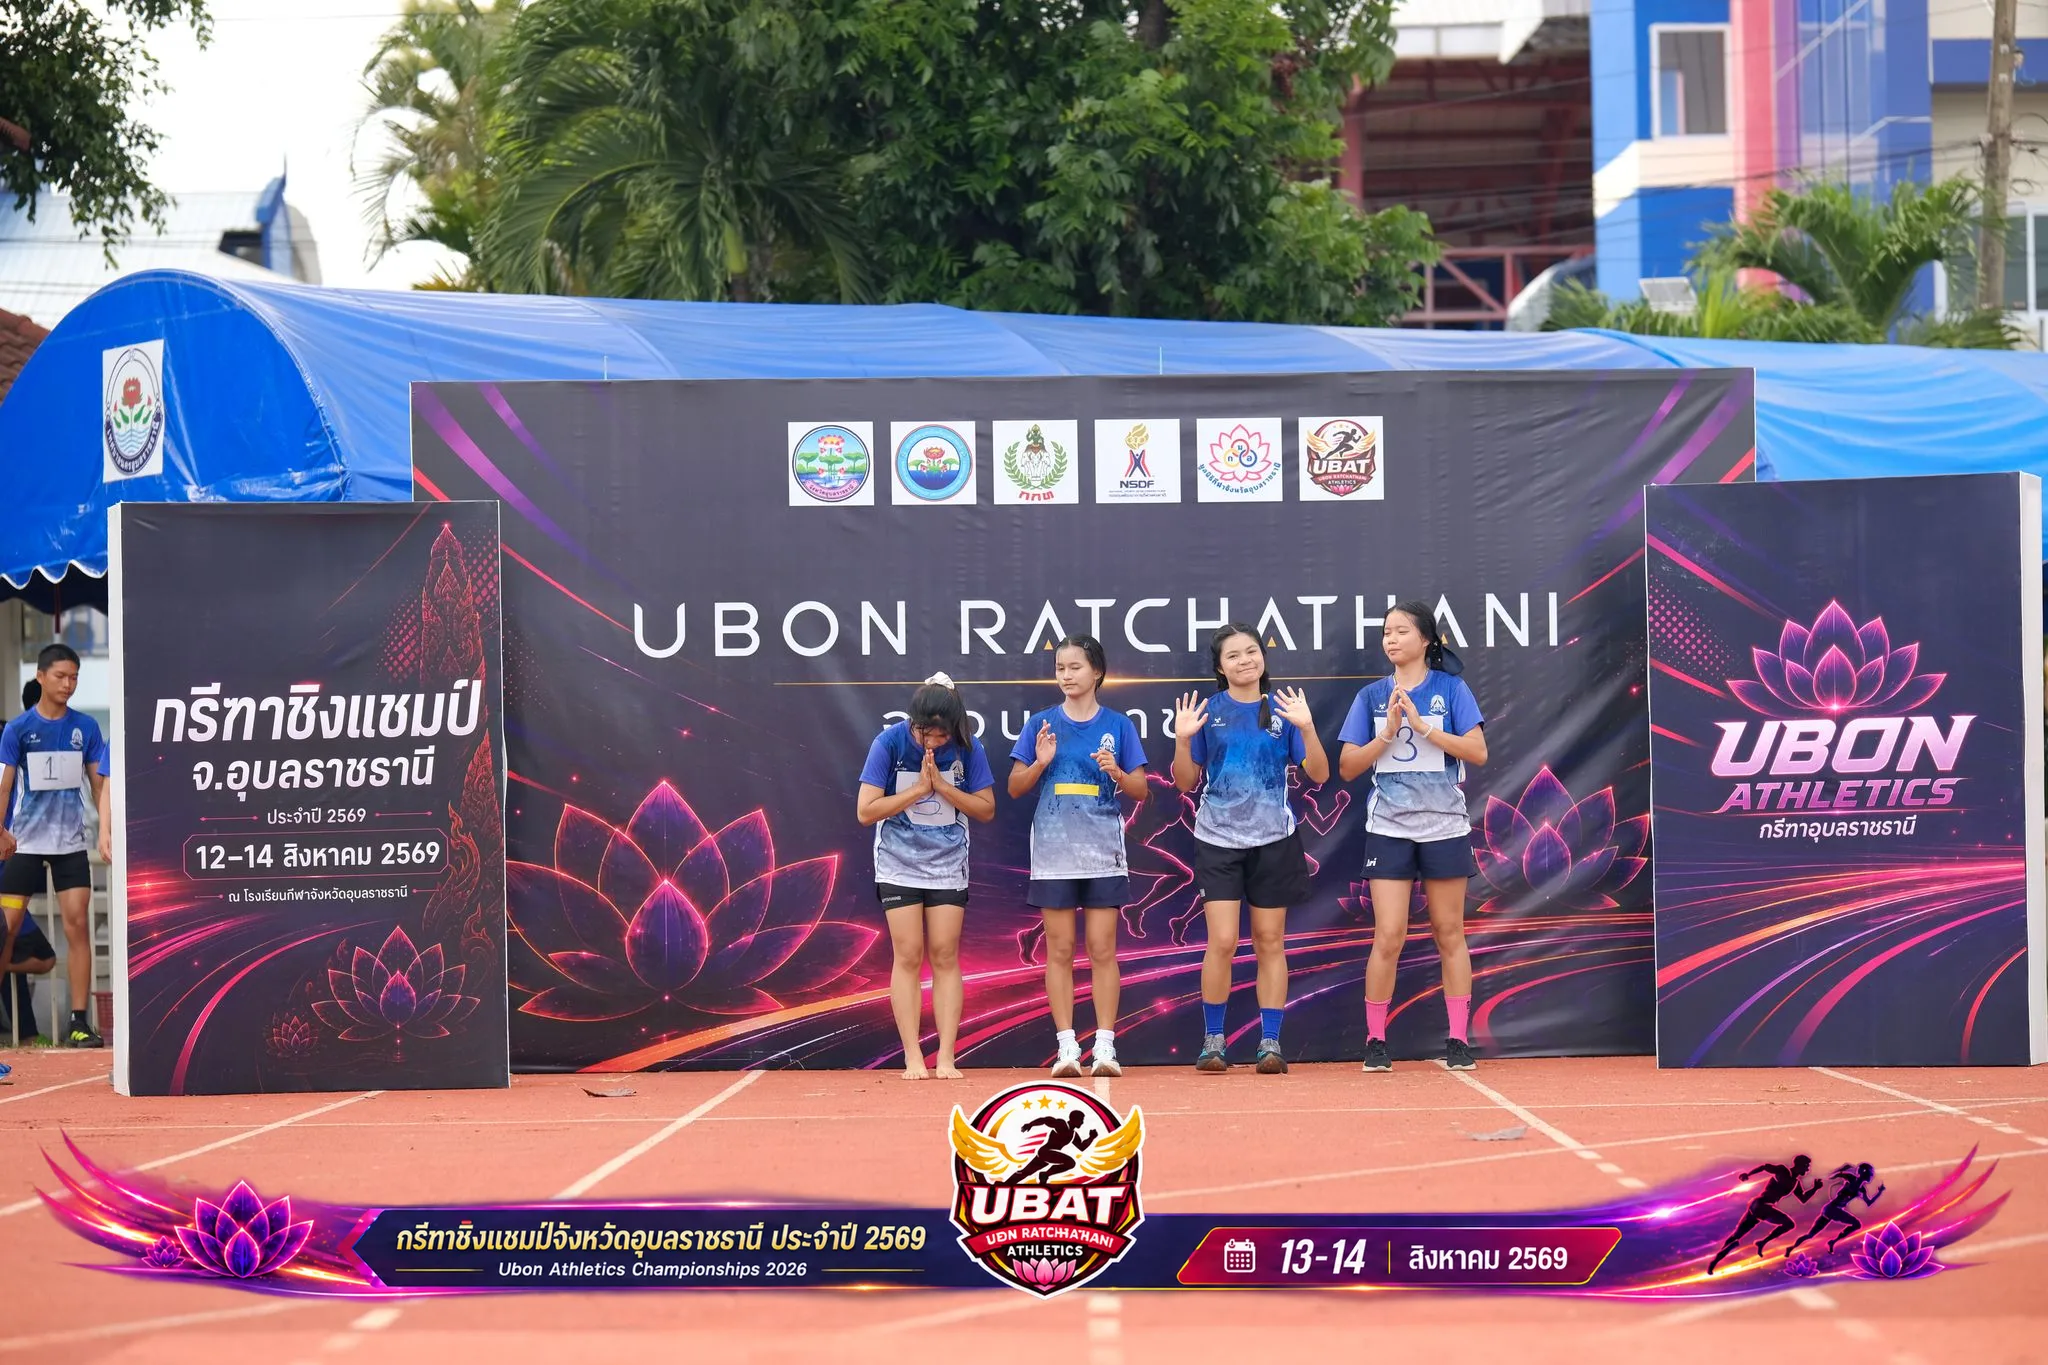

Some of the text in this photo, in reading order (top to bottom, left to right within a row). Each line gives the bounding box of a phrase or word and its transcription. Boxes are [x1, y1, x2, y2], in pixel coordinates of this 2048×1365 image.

[1312, 459, 1371, 475] UBAT
[1119, 480, 1155, 489] NSDF
[633, 591, 1559, 659] UBON RATCHATHANI
[151, 678, 483, 744] กรีฑาชิงแชมป์
[1391, 725, 1418, 762] 3
[1711, 714, 1977, 777] UBON
[192, 744, 436, 802] จ.อุบลราชธานี
[1714, 777, 1966, 813] ATHLETICS
[267, 806, 367, 825] ประจำปี 2569
[1759, 814, 1917, 843] กรีฑาอุบลราชธานี
[283, 842, 372, 868] สิงหาคม
[380, 841, 440, 865] 2569
[228, 884, 408, 904] ณ โรงเรียนกีฬาจังหวัดอุบลราชธานี
